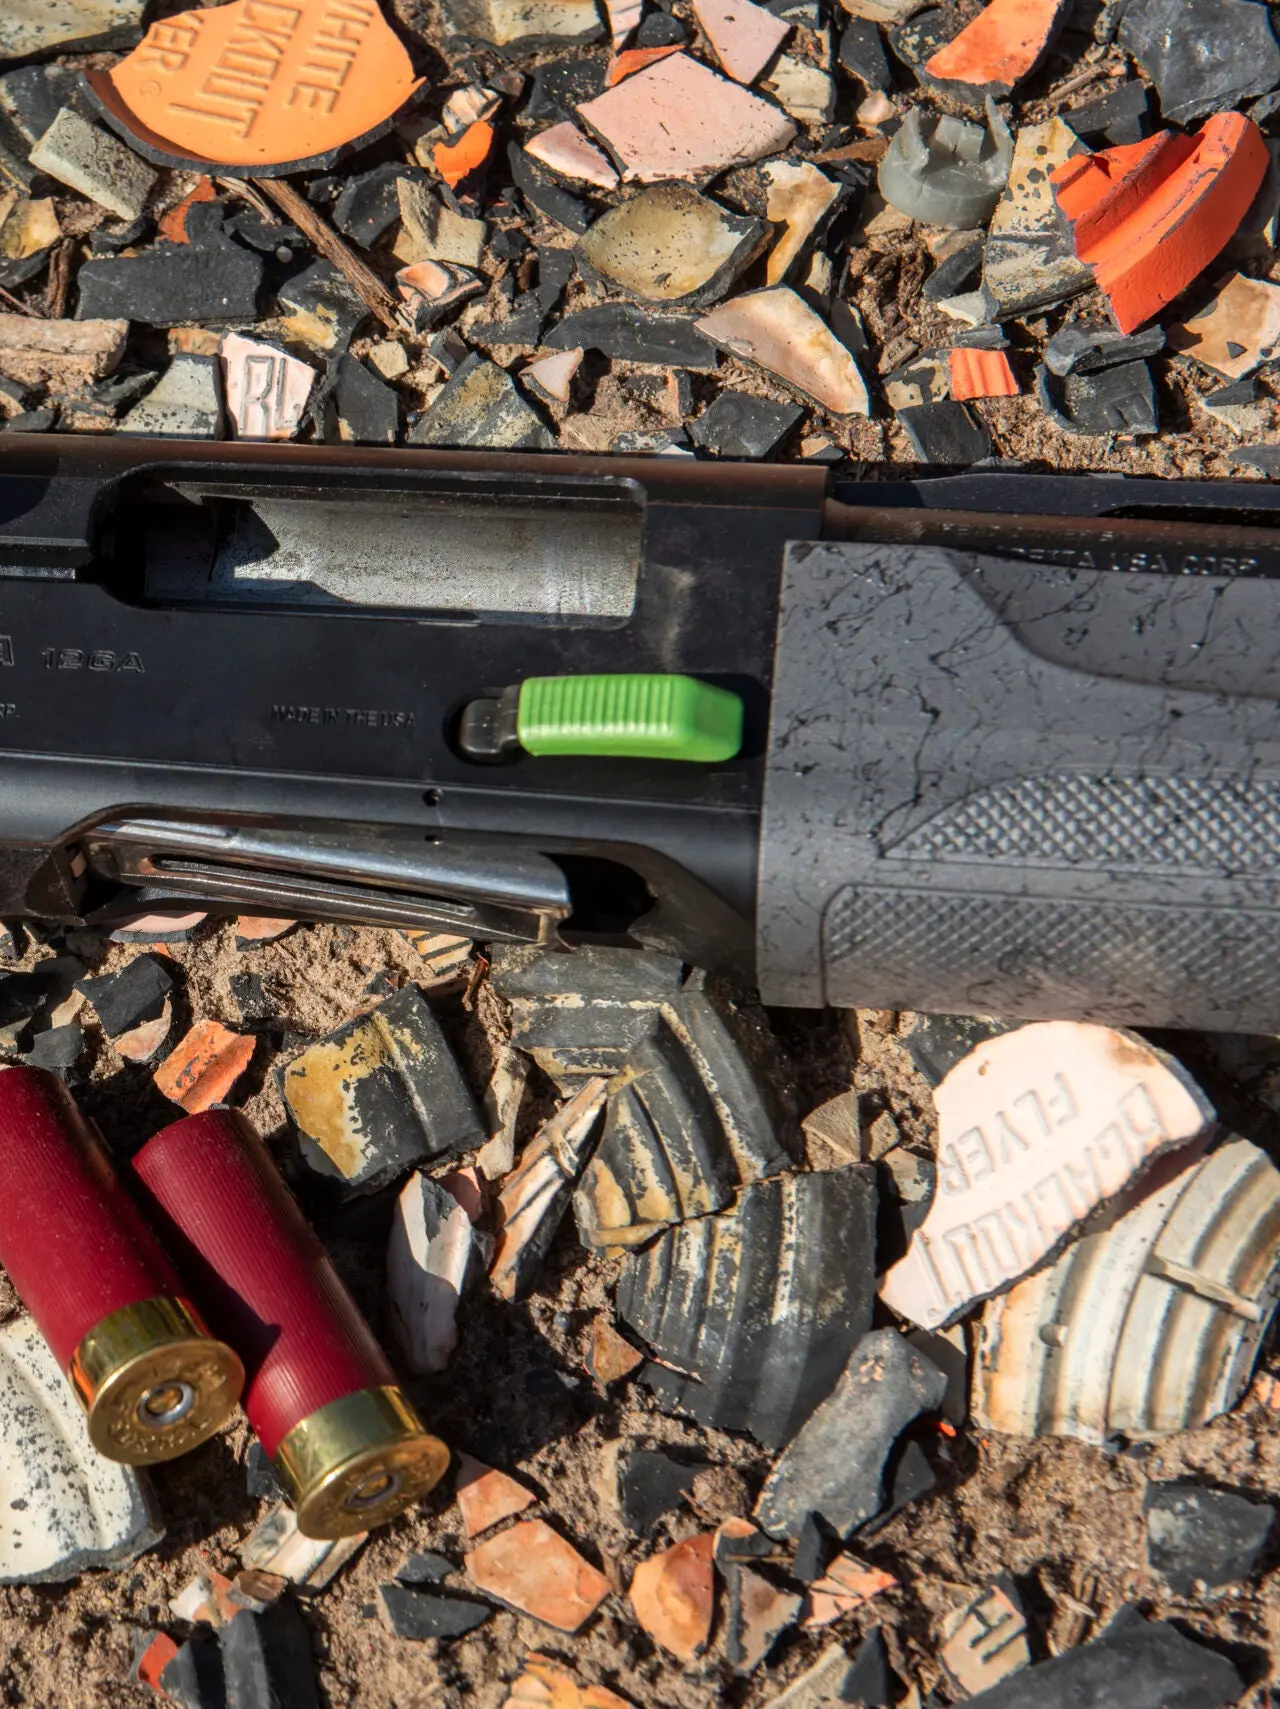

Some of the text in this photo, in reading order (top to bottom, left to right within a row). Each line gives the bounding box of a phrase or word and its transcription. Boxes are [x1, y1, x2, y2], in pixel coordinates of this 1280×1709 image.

[41, 647, 146, 674] 12GA
[271, 704, 417, 729] MADE IN THE USA
[937, 1071, 1079, 1198] FLYER
